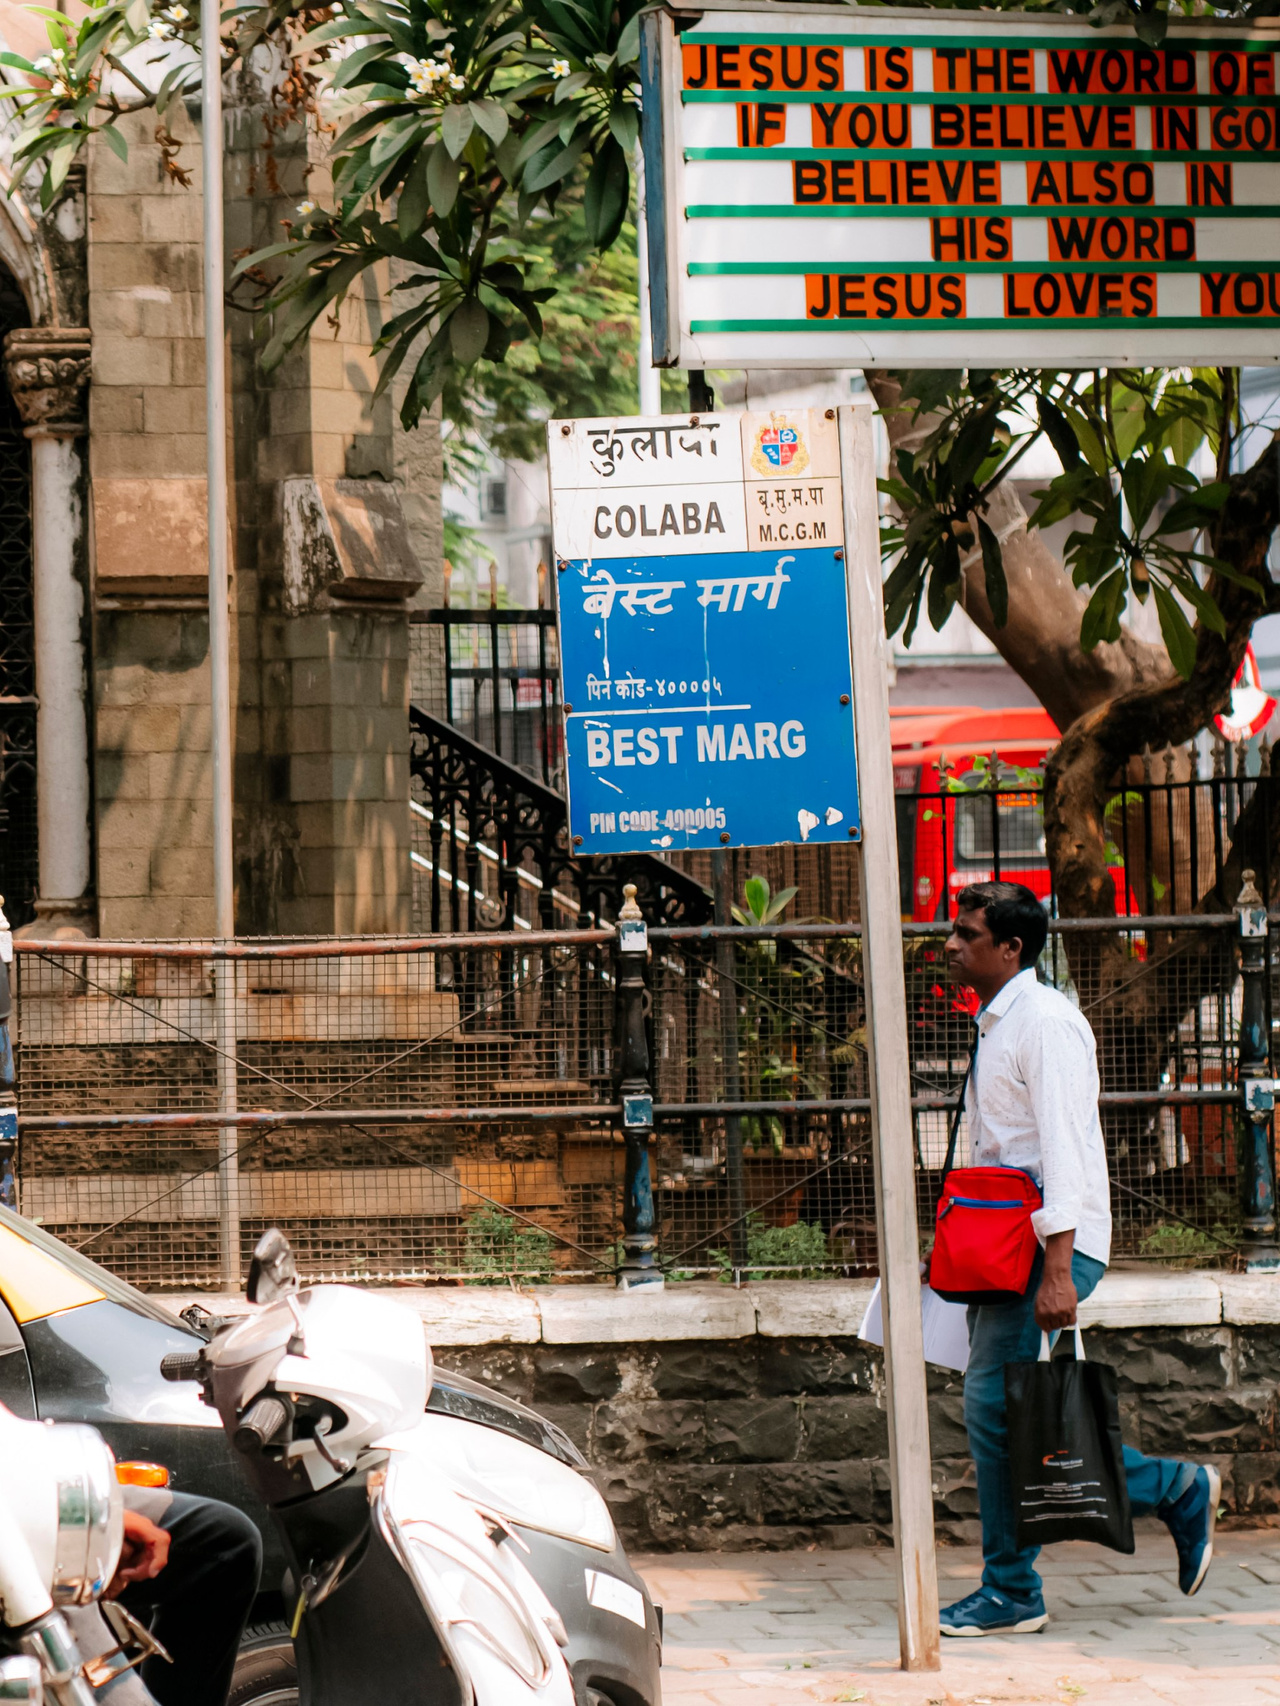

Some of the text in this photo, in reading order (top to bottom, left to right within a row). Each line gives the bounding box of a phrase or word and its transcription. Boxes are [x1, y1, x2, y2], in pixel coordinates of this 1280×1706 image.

[686, 45, 1273, 96] JESUS IS THE WORD OF
[740, 102, 1280, 151] IF YOU BELIEVE IN GO
[795, 160, 1232, 206] BELIEVE ALSO IN
[933, 216, 1196, 261] HIS WORD
[809, 274, 963, 318] JESUS
[1006, 273, 1154, 318] LOVES
[594, 501, 726, 539] COLABA
[759, 522, 827, 542] M.C.G.M
[582, 556, 795, 619] बेस्ट मार्ग
[586, 673, 612, 700] पिन
[587, 720, 806, 767] BEST MARG
[590, 812, 616, 834] PIN
